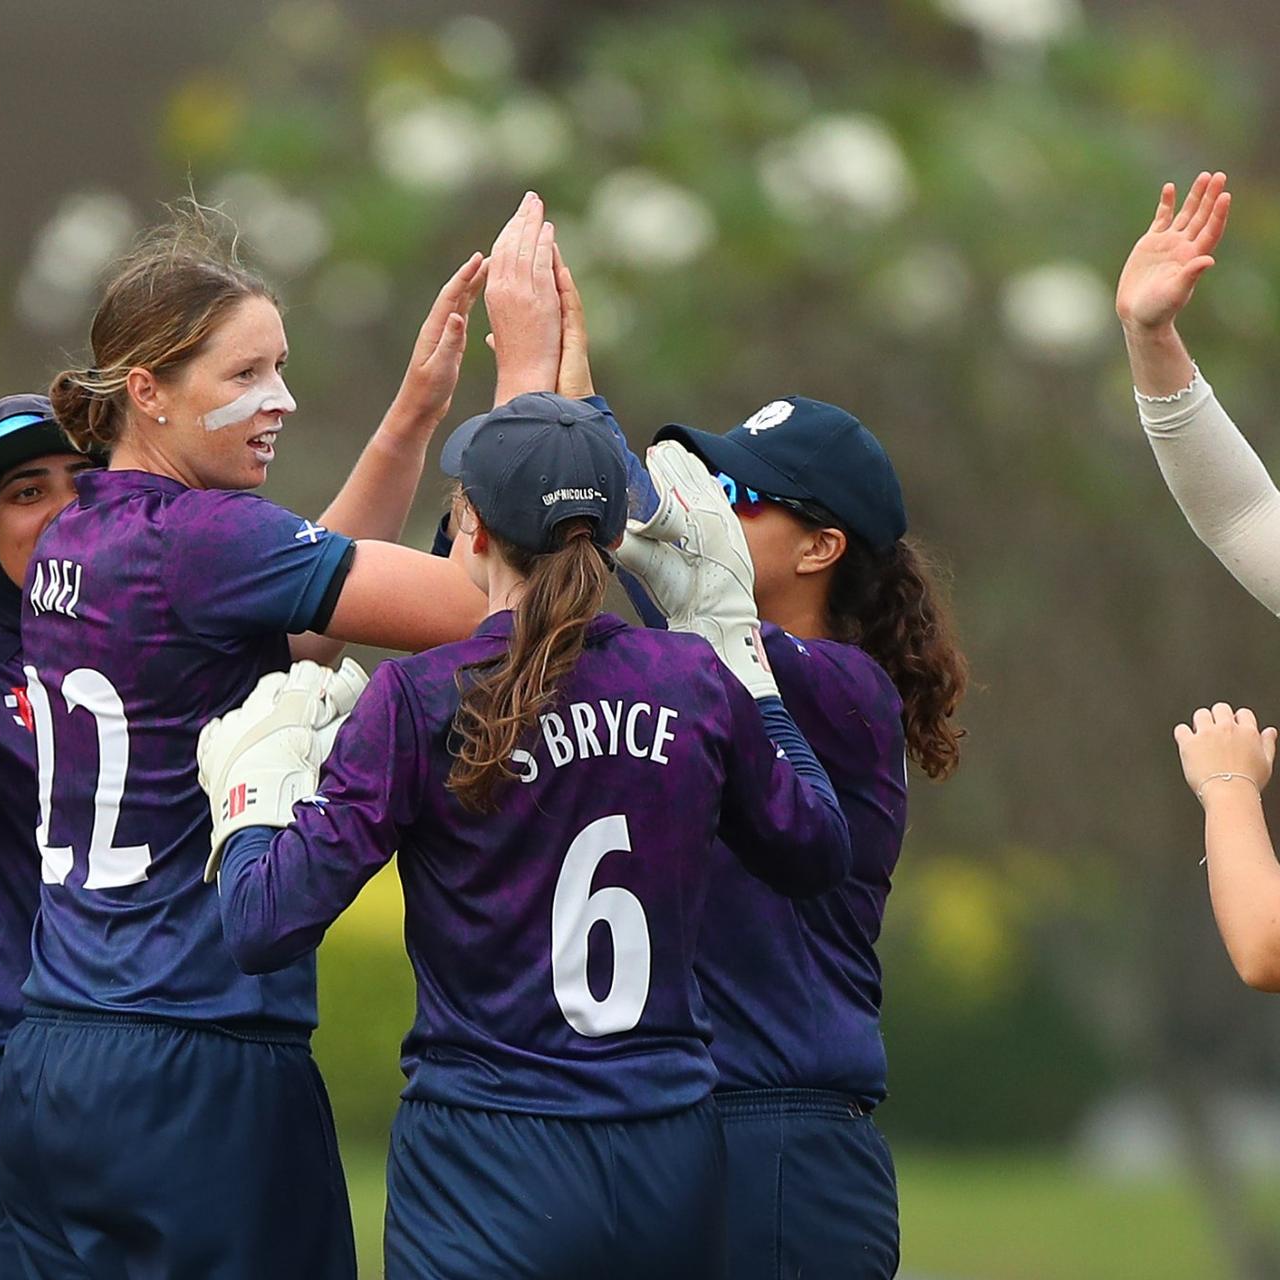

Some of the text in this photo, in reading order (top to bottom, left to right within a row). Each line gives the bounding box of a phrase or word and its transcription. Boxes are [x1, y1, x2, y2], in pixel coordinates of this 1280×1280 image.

[30, 559, 82, 619] ABEL
[538, 699, 680, 769] BRYCE
[552, 814, 651, 1038] 6
